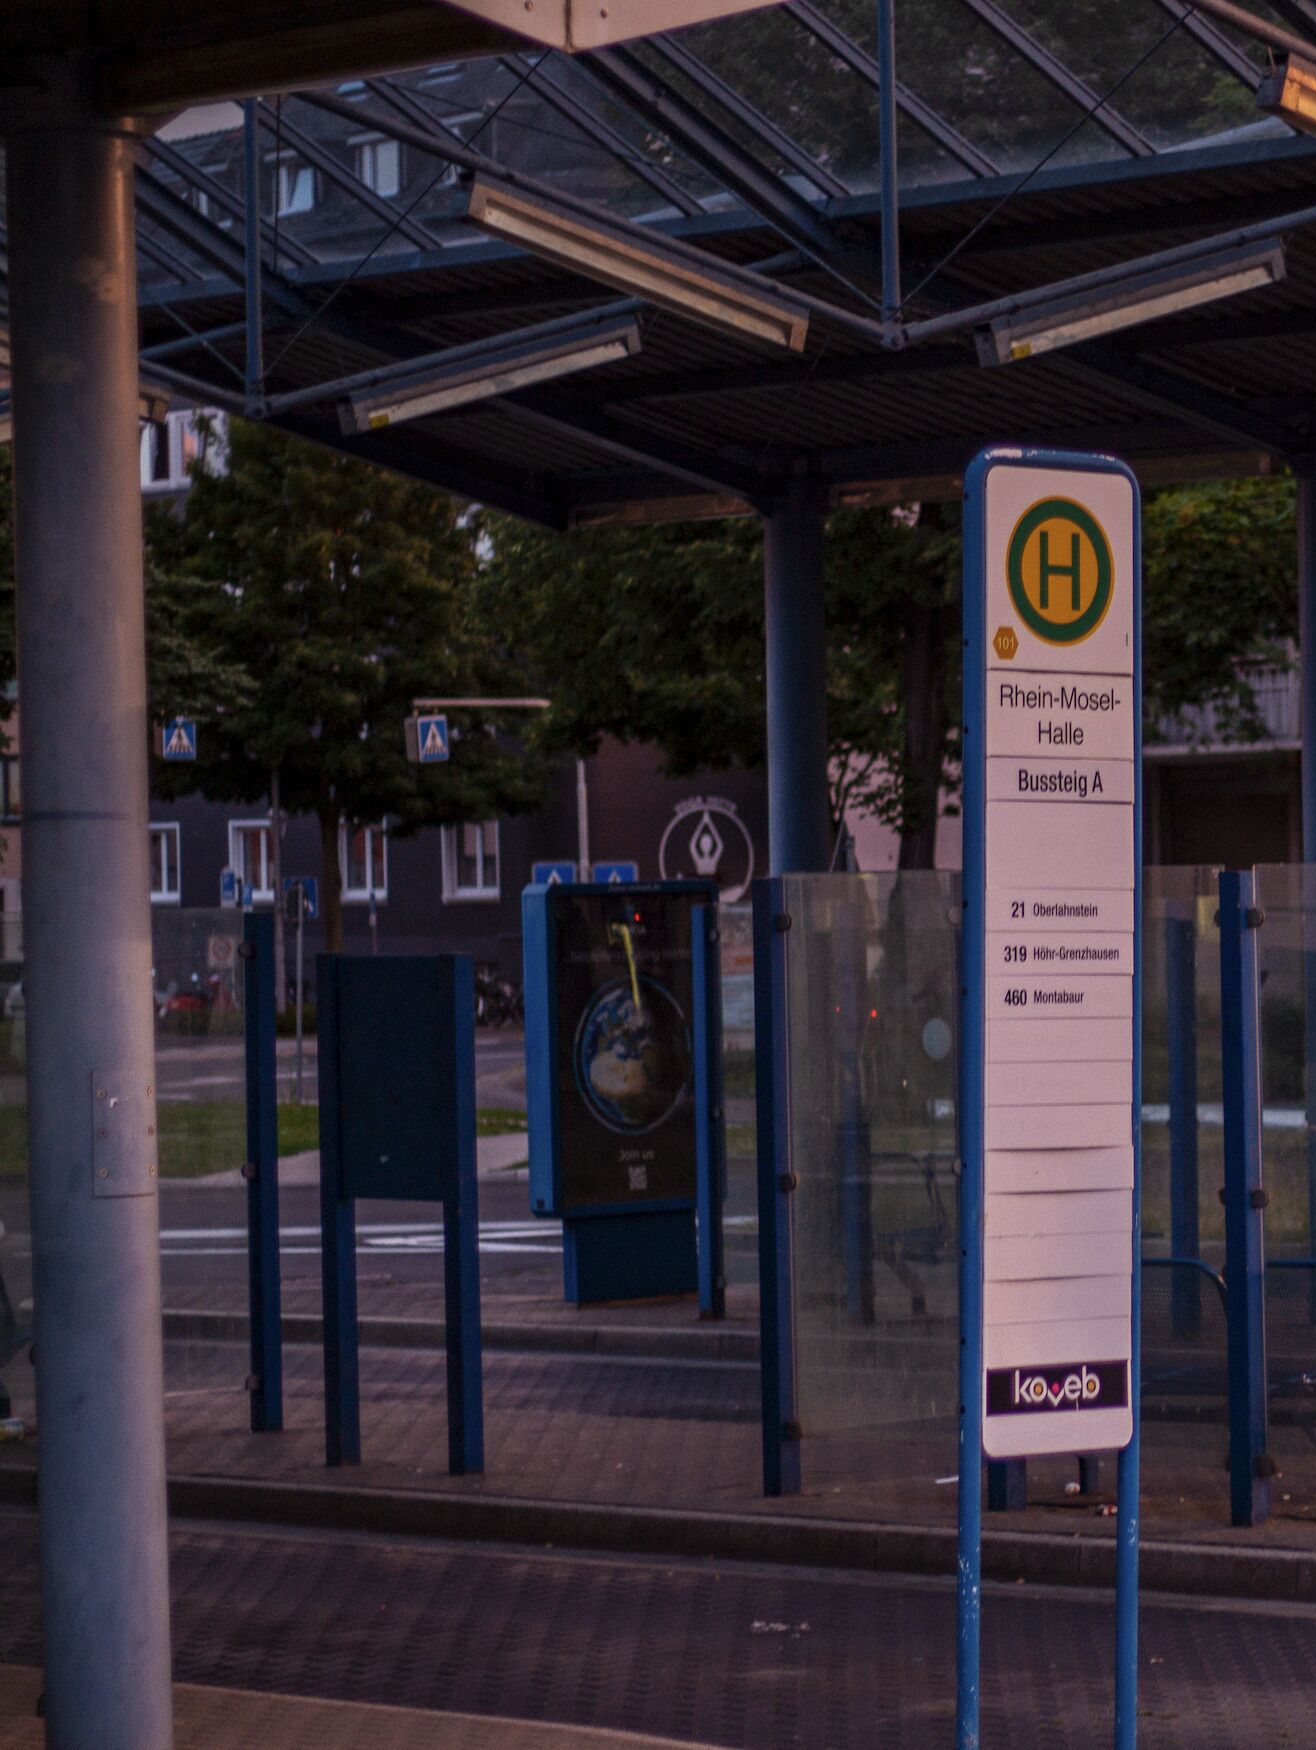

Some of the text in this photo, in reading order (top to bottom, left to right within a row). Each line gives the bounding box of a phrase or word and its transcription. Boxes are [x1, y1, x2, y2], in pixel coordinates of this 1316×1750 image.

[1039, 531, 1080, 611] H
[997, 637, 1015, 650] 101
[1000, 684, 1121, 711] Rhein-Mosel-
[1038, 722, 1084, 745] Halle
[1018, 770, 1103, 797] Bussteig A
[1011, 902, 1098, 918] 21 Oberlahnstein
[1004, 945, 1119, 962] 319 Höhr-Grenzhausen
[1004, 989, 1084, 1006] 460 Montabaur
[1014, 1365, 1100, 1407] koveb
